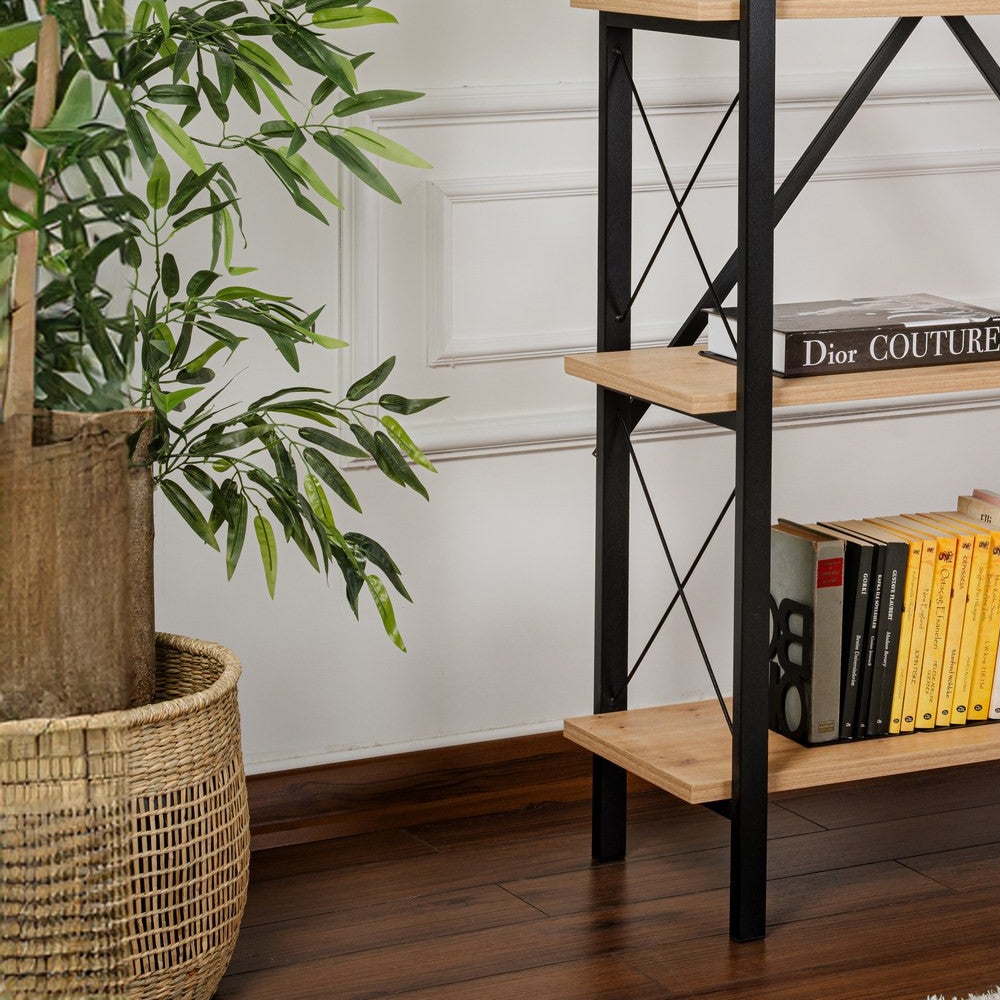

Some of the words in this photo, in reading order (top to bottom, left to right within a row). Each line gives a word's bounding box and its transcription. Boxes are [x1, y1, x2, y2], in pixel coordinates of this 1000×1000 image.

[803, 339, 857, 367] Dior
[870, 326, 1000, 361] COUTURE
[889, 569, 898, 593] GUSTAVE
[887, 594, 896, 621] FLAUBERT
[933, 606, 946, 650] Efsaneleri
[881, 650, 890, 668] Bovary
